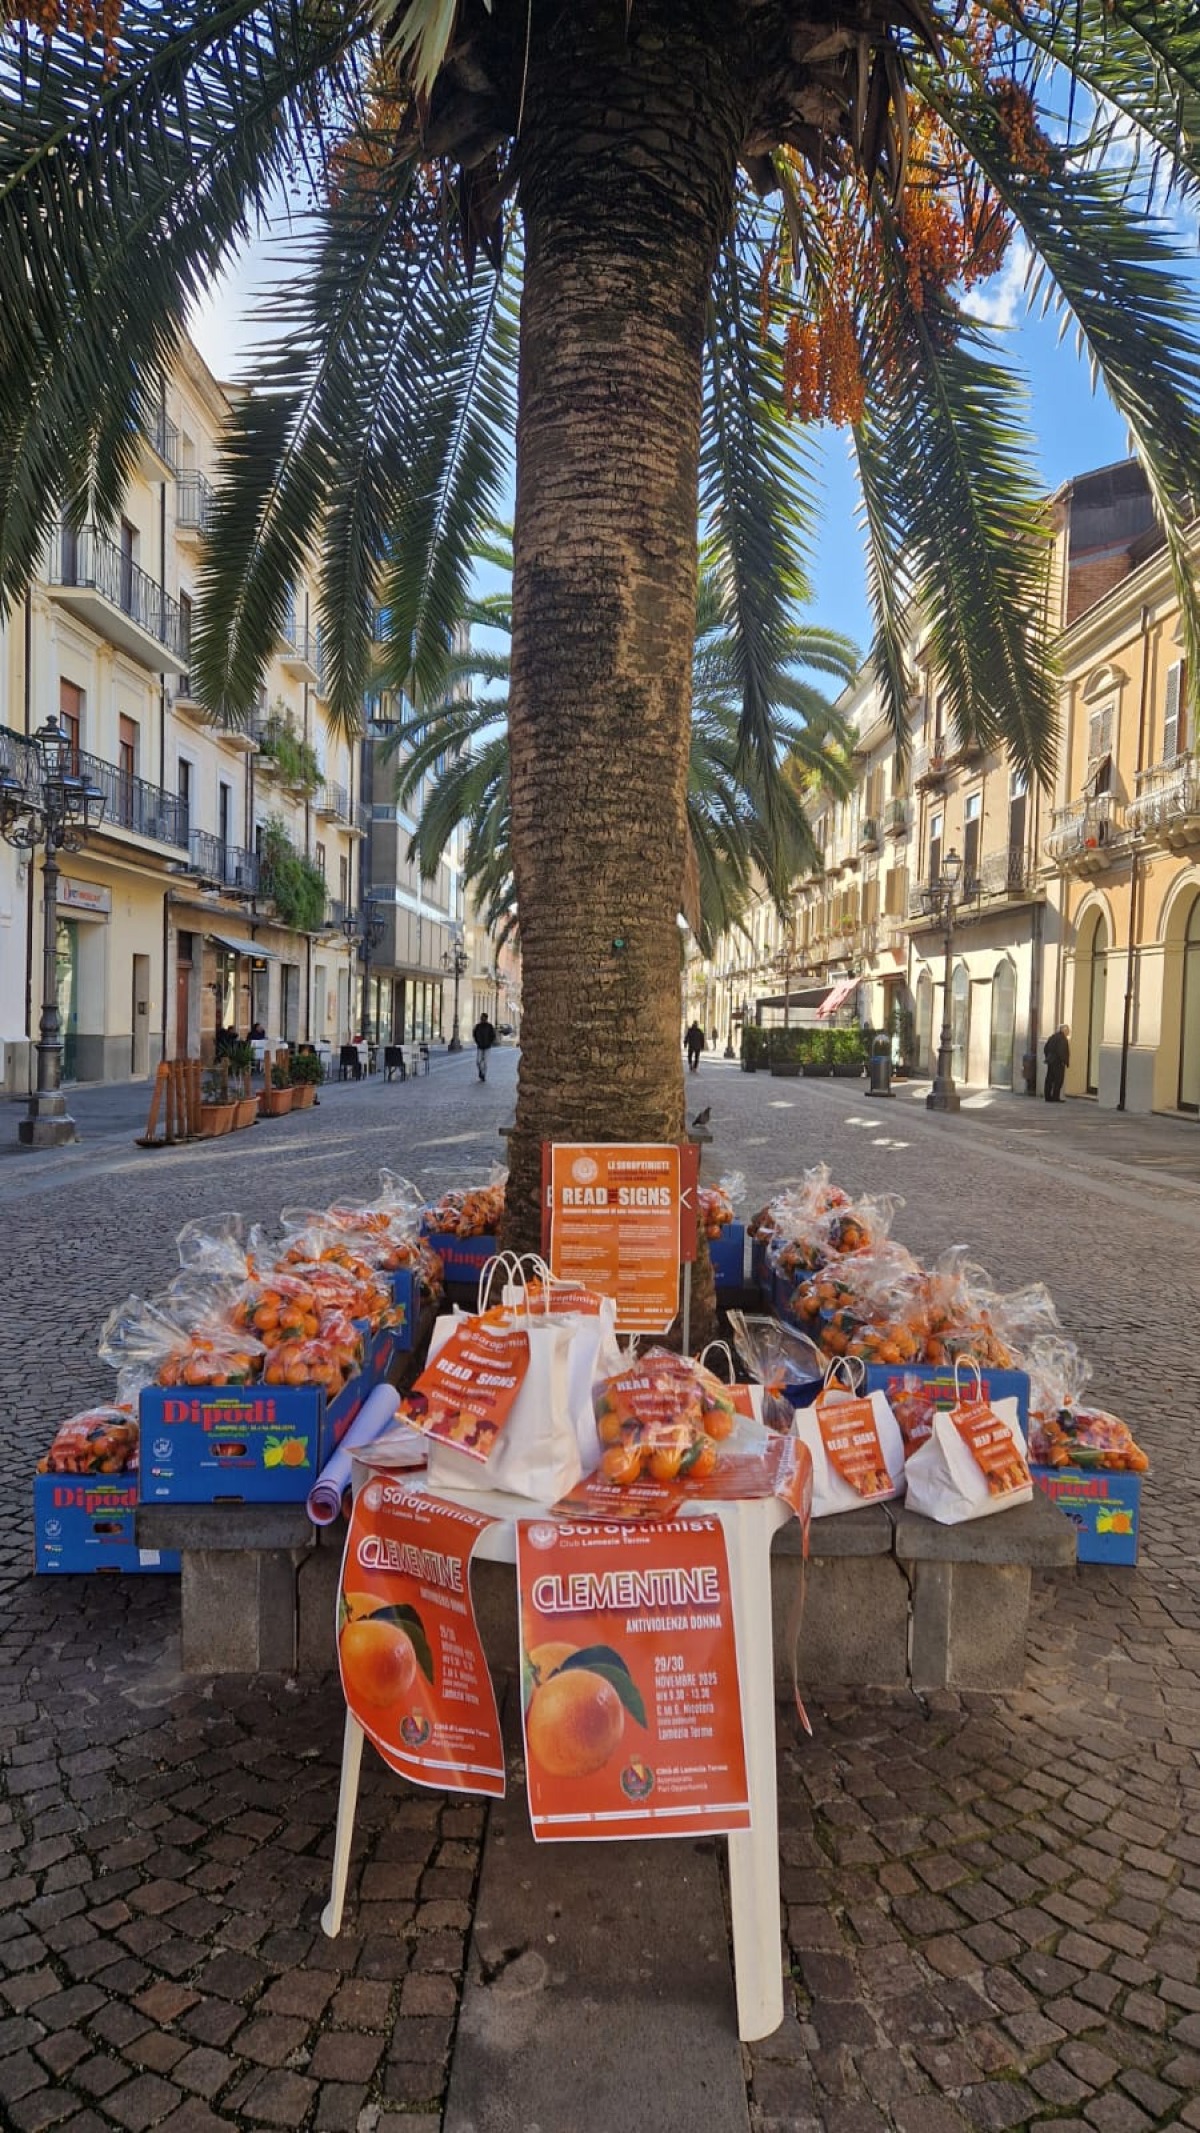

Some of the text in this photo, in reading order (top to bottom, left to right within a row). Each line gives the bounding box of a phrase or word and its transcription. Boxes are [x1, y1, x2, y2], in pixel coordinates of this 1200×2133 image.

[562, 1187, 608, 1206] READ
[617, 1187, 671, 1206] SIGNS
[436, 1358, 473, 1381] READ
[476, 1373, 517, 1389] SIGNS
[616, 1377, 650, 1392] READ
[163, 1398, 277, 1432] Dipodi
[53, 1486, 138, 1515] Dipod
[357, 1535, 465, 1594] CLEMENTINE
[532, 1567, 721, 1614] CLEMENTINE
[626, 1614, 722, 1634] ANTIVIOLENZA DONNA
[656, 1674, 696, 1688] NOVEMBRE
